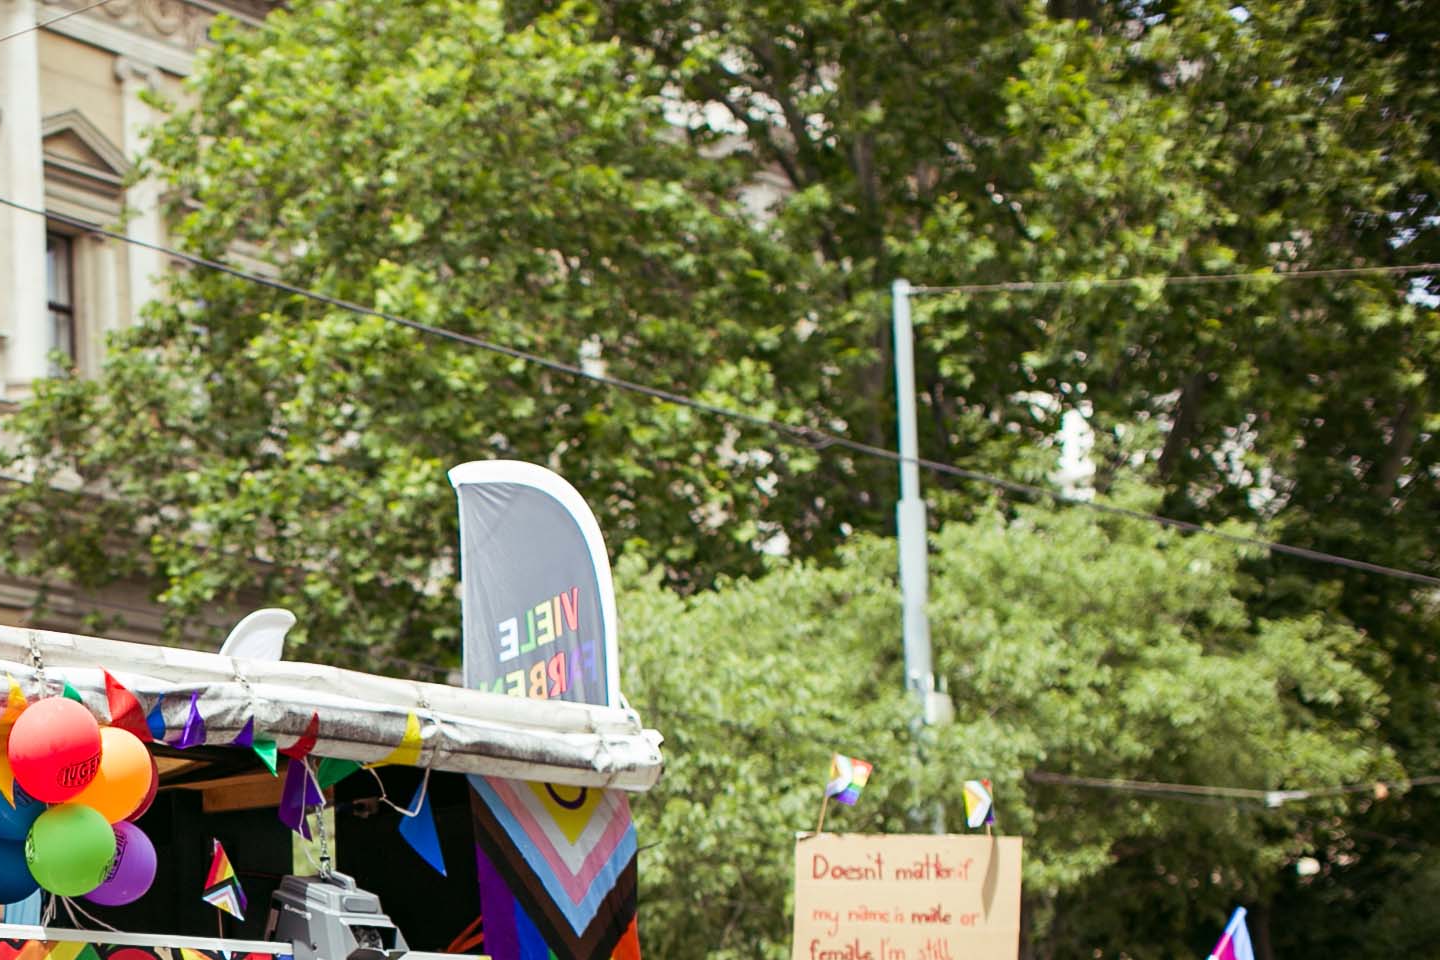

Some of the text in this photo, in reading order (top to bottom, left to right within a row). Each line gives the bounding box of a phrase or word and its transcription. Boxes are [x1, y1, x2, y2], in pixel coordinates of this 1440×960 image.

[812, 852, 974, 881] Doesn't matter if
[812, 903, 979, 937] my name is male or
